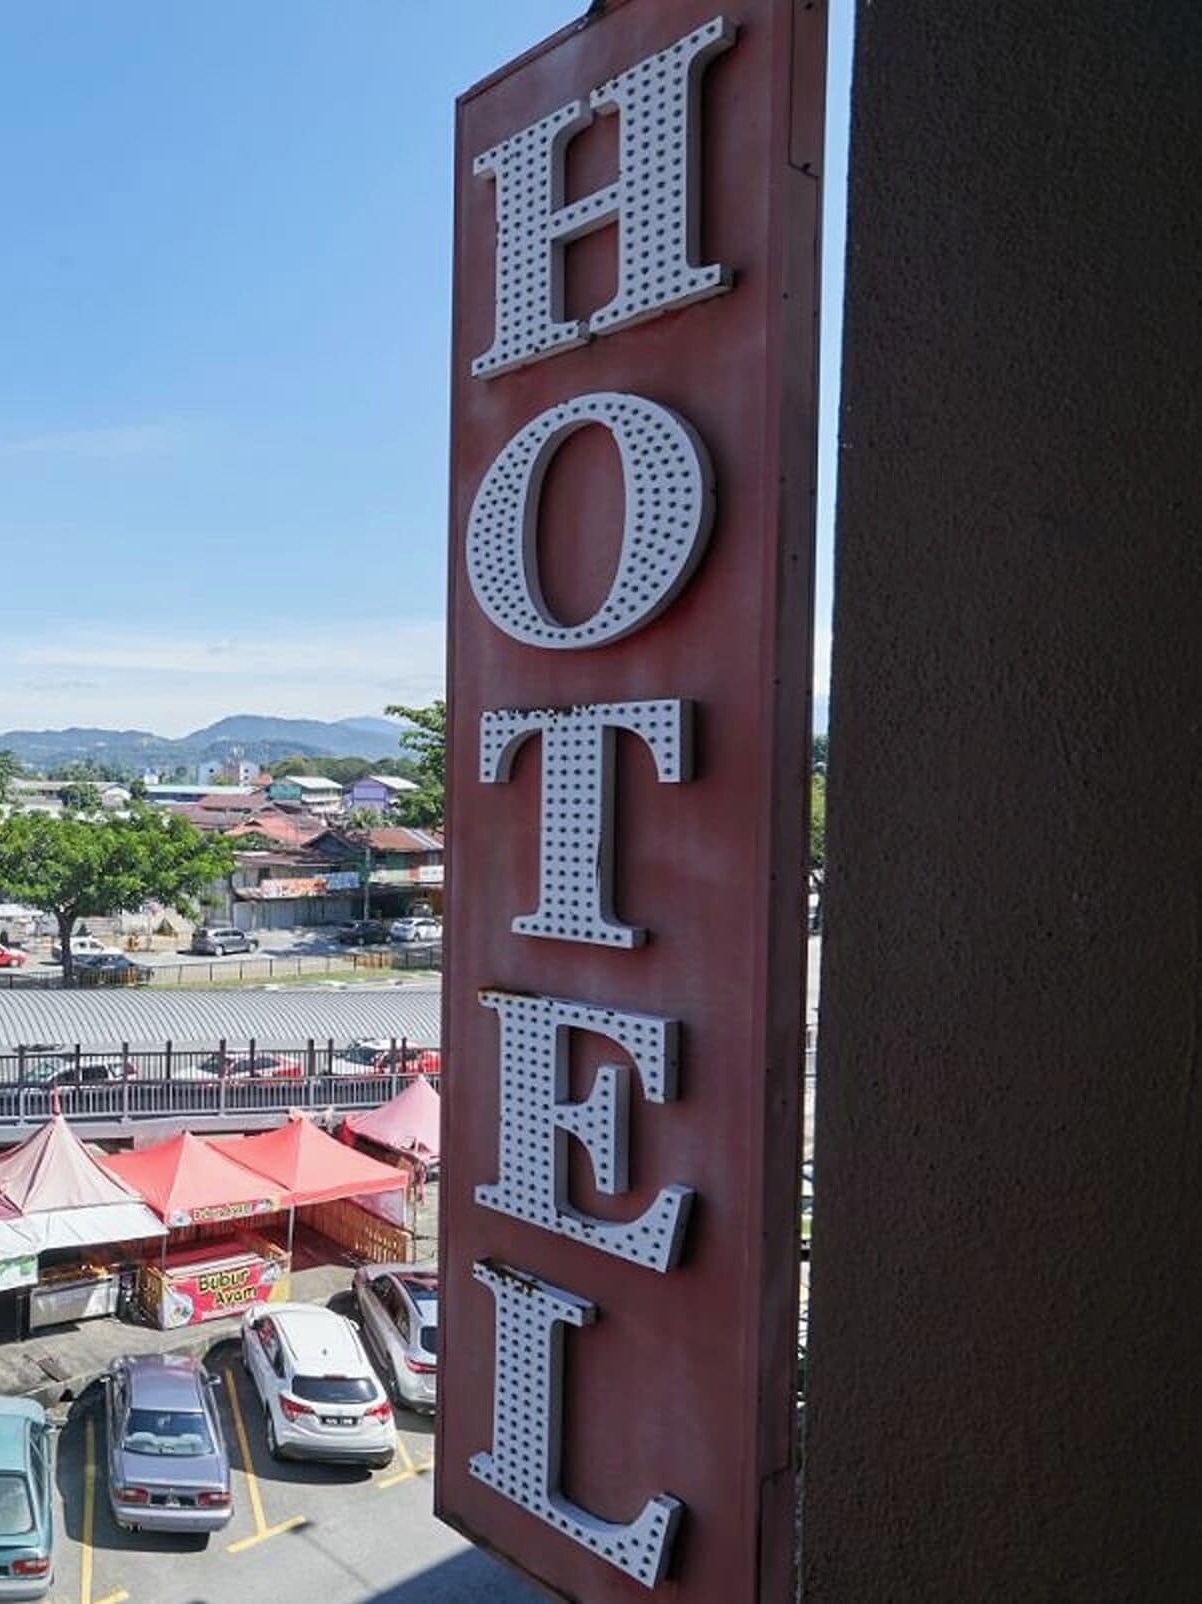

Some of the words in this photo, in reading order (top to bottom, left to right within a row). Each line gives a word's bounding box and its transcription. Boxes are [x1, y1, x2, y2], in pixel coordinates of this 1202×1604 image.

[464, 16, 739, 1588] HOTEL
[199, 1269, 248, 1291] Bubur
[216, 1287, 257, 1304] Ayam
